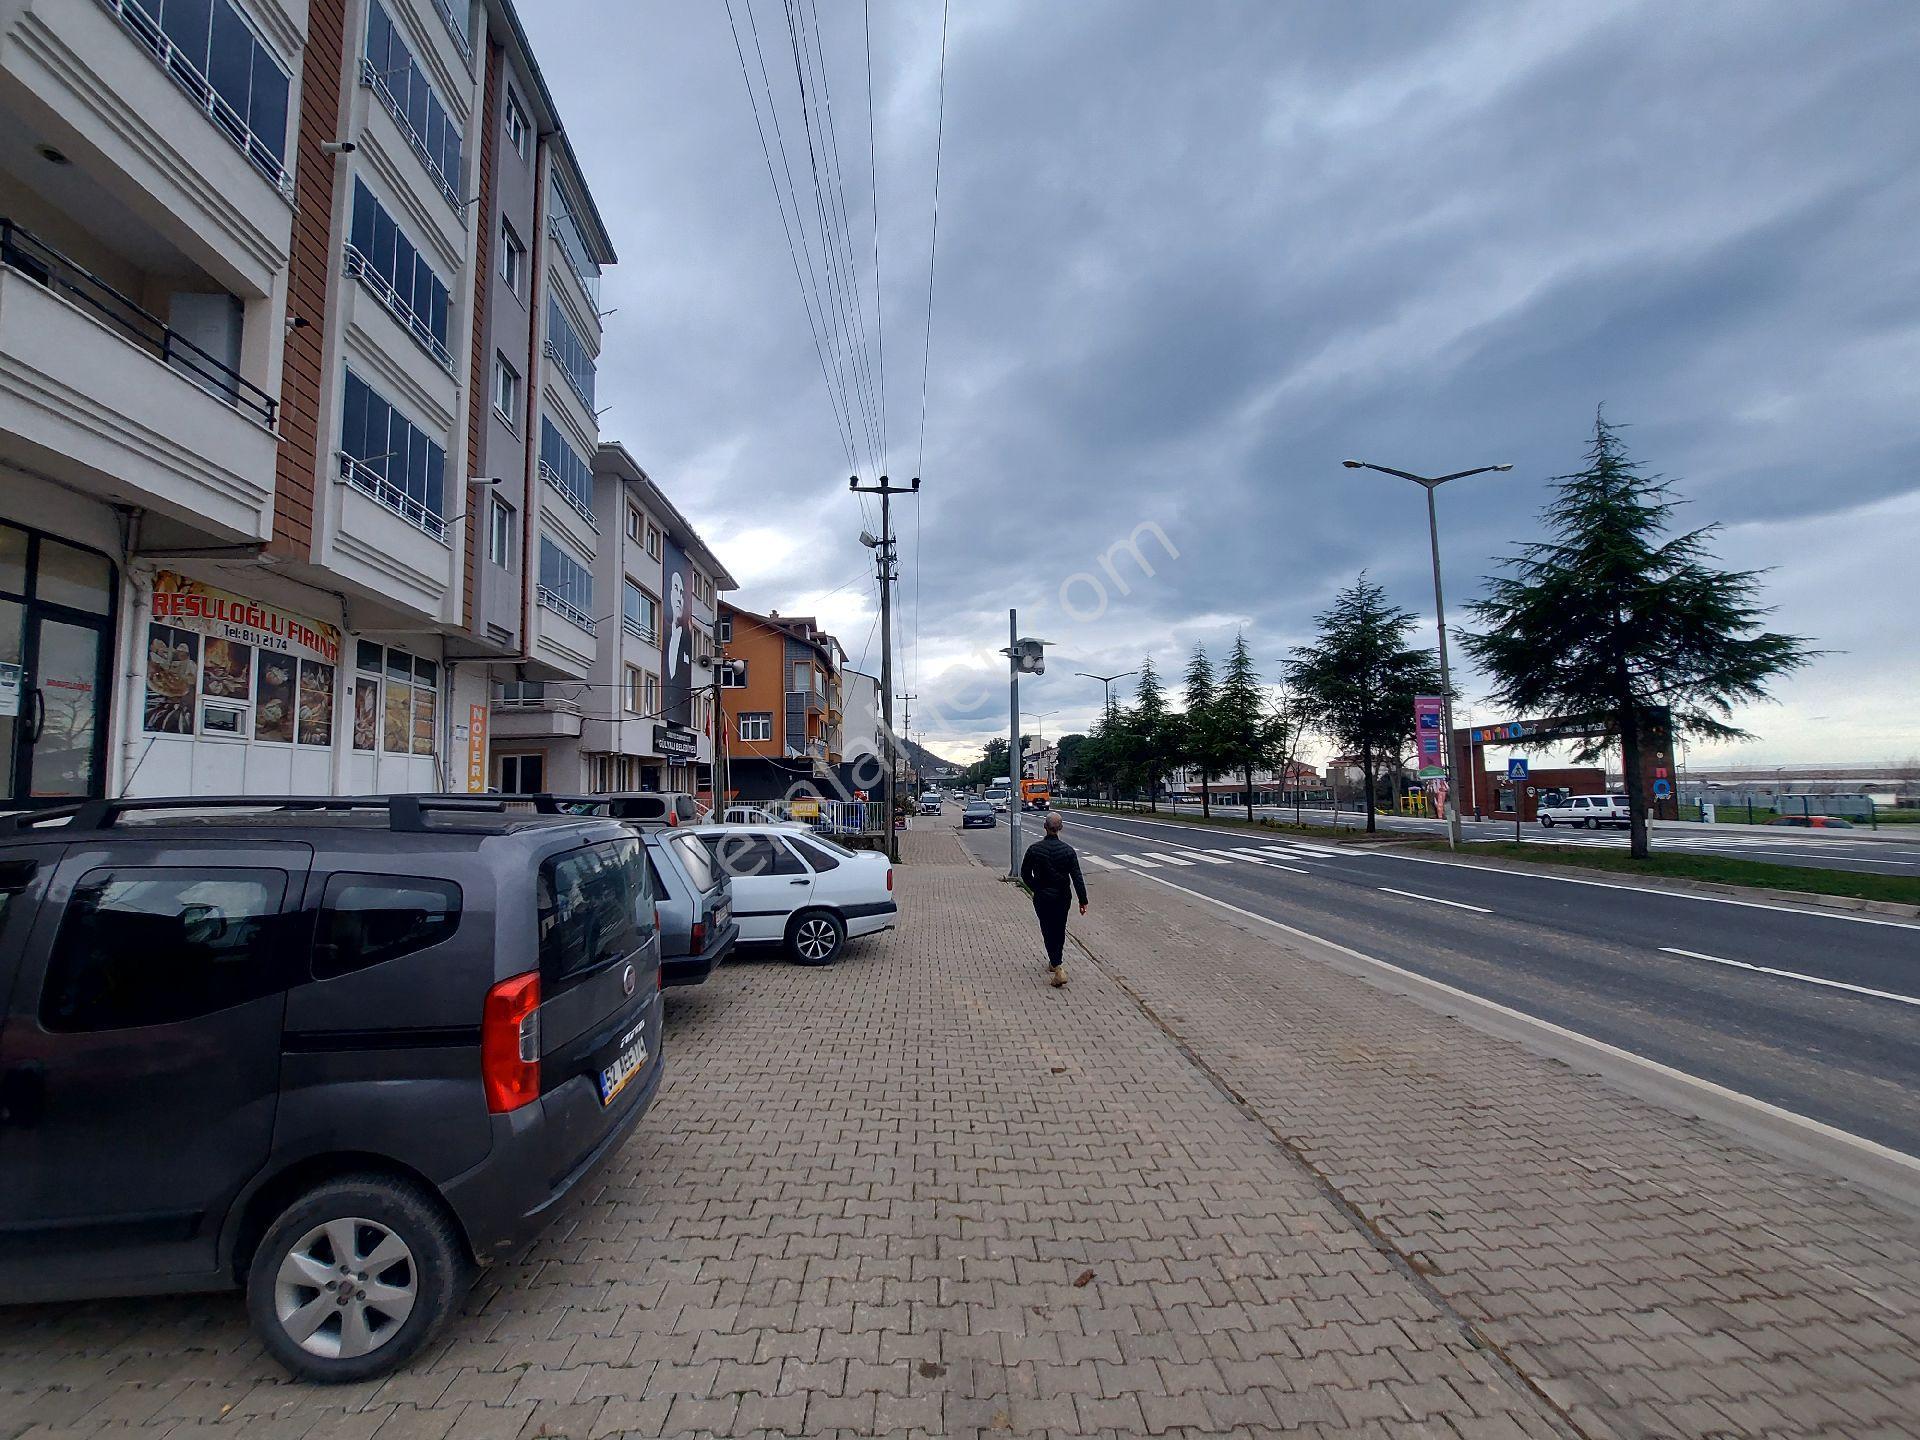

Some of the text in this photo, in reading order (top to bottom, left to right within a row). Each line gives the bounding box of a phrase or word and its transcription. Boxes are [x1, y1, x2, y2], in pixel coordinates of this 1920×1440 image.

[152, 592, 284, 636] RESULOĞLU
[223, 625, 241, 638] Tel:
[243, 631, 260, 645] 811
[471, 707, 483, 777] NOTER
